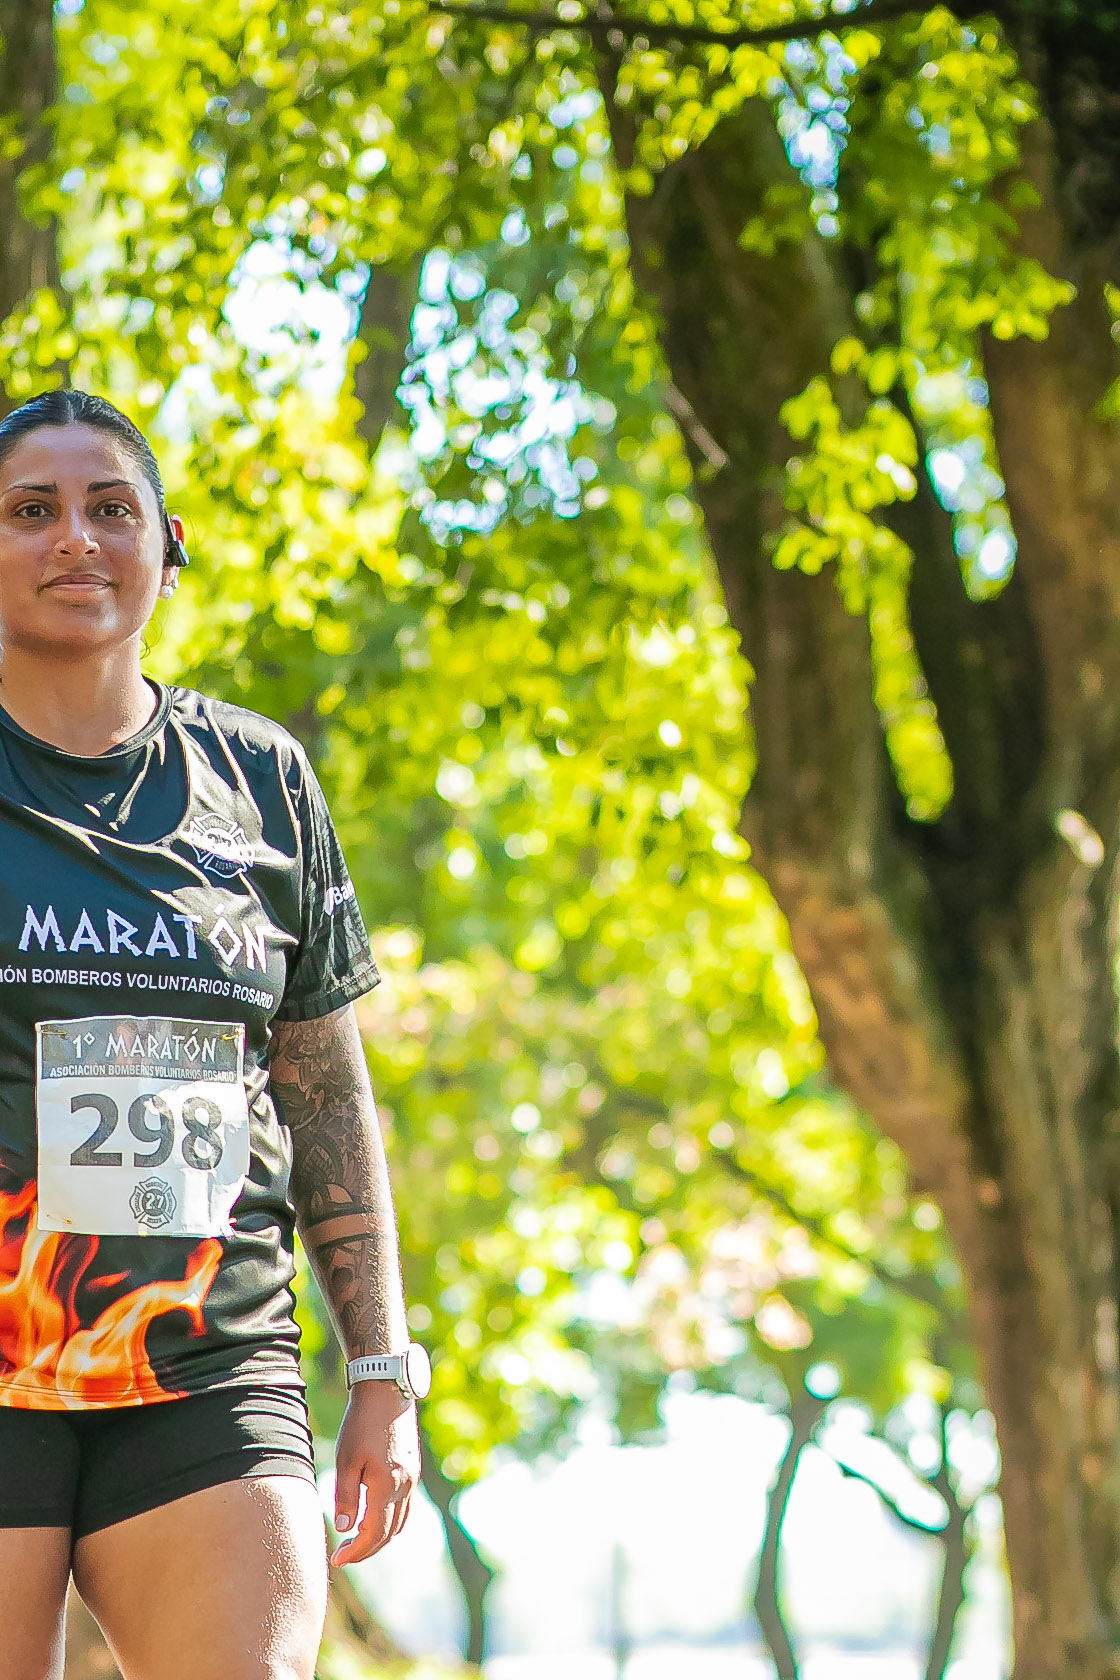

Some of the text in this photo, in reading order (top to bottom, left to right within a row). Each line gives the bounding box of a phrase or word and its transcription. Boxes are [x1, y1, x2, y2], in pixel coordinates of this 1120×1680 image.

[18, 903, 268, 974] MARATÓN
[31, 968, 122, 987] BOMBEROS
[126, 972, 231, 997] VOLUNTARIOS
[231, 984, 275, 1010] ROSARIO
[105, 1027, 218, 1063] MARATÓN
[50, 1063, 236, 1083] ASOCIACIÓN BOMBEROS VOLUNTARIOS ROSARIO
[69, 1092, 224, 1171] 298
[145, 1191, 165, 1210] 27
